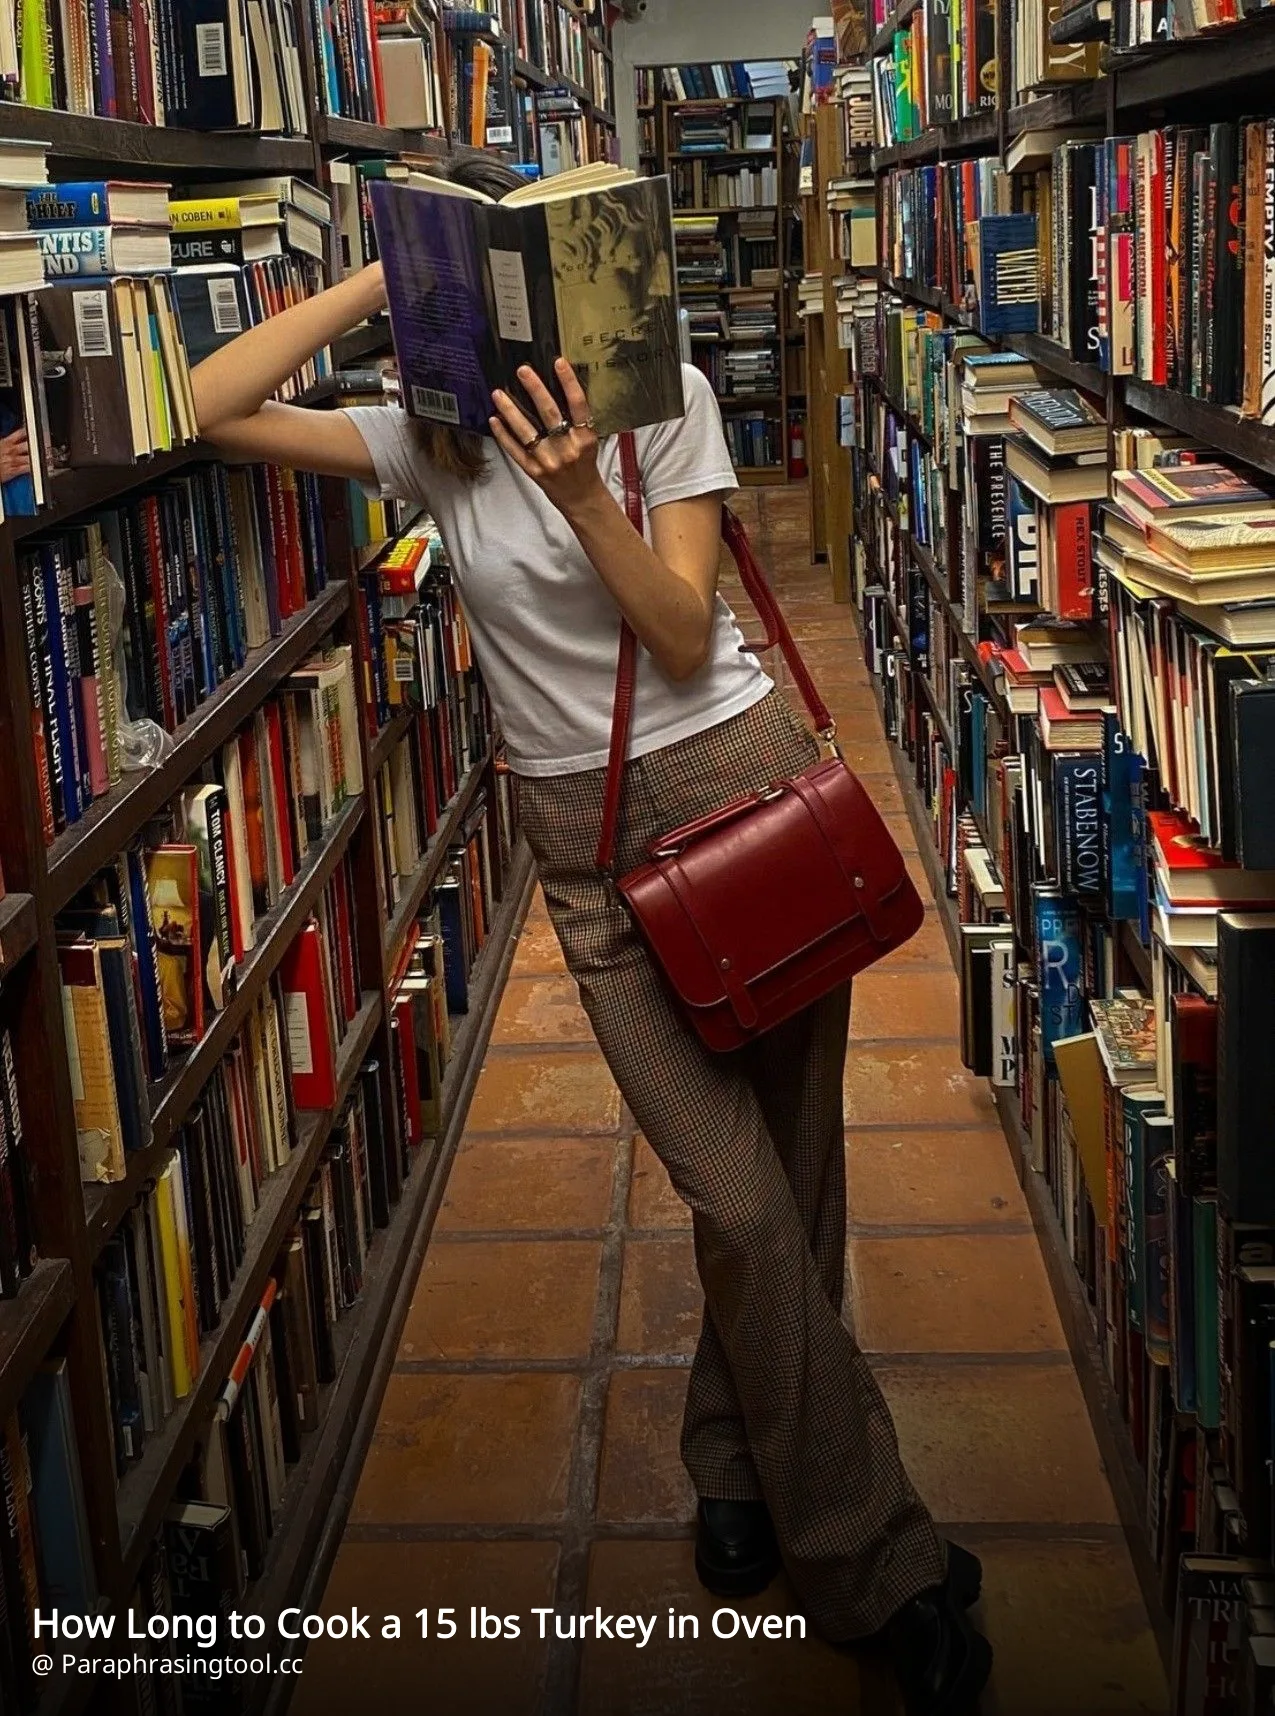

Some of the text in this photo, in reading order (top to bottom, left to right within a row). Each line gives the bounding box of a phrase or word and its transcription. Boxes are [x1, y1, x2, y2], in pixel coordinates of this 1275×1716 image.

[850, 97, 874, 148] JUDGE
[181, 211, 213, 223] COBEN
[1164, 174, 1173, 209] SMITH
[1263, 168, 1275, 251] EMPTY
[41, 231, 94, 255] NTIS
[44, 254, 79, 275] ND
[1264, 283, 1272, 319] TODD
[860, 320, 877, 373] SCAVENGER
[1264, 323, 1272, 367] SCOTT
[988, 443, 1006, 538] THE PRESENCE
[1075, 516, 1087, 584] REX STOUT
[32, 566, 46, 625] COONTS
[22, 584, 43, 708] STEPHEN COONTS
[43, 655, 64, 785] FINAL FLIGHT
[210, 808, 226, 887] TOM CLANCY
[1073, 768, 1100, 892] STABENOW
